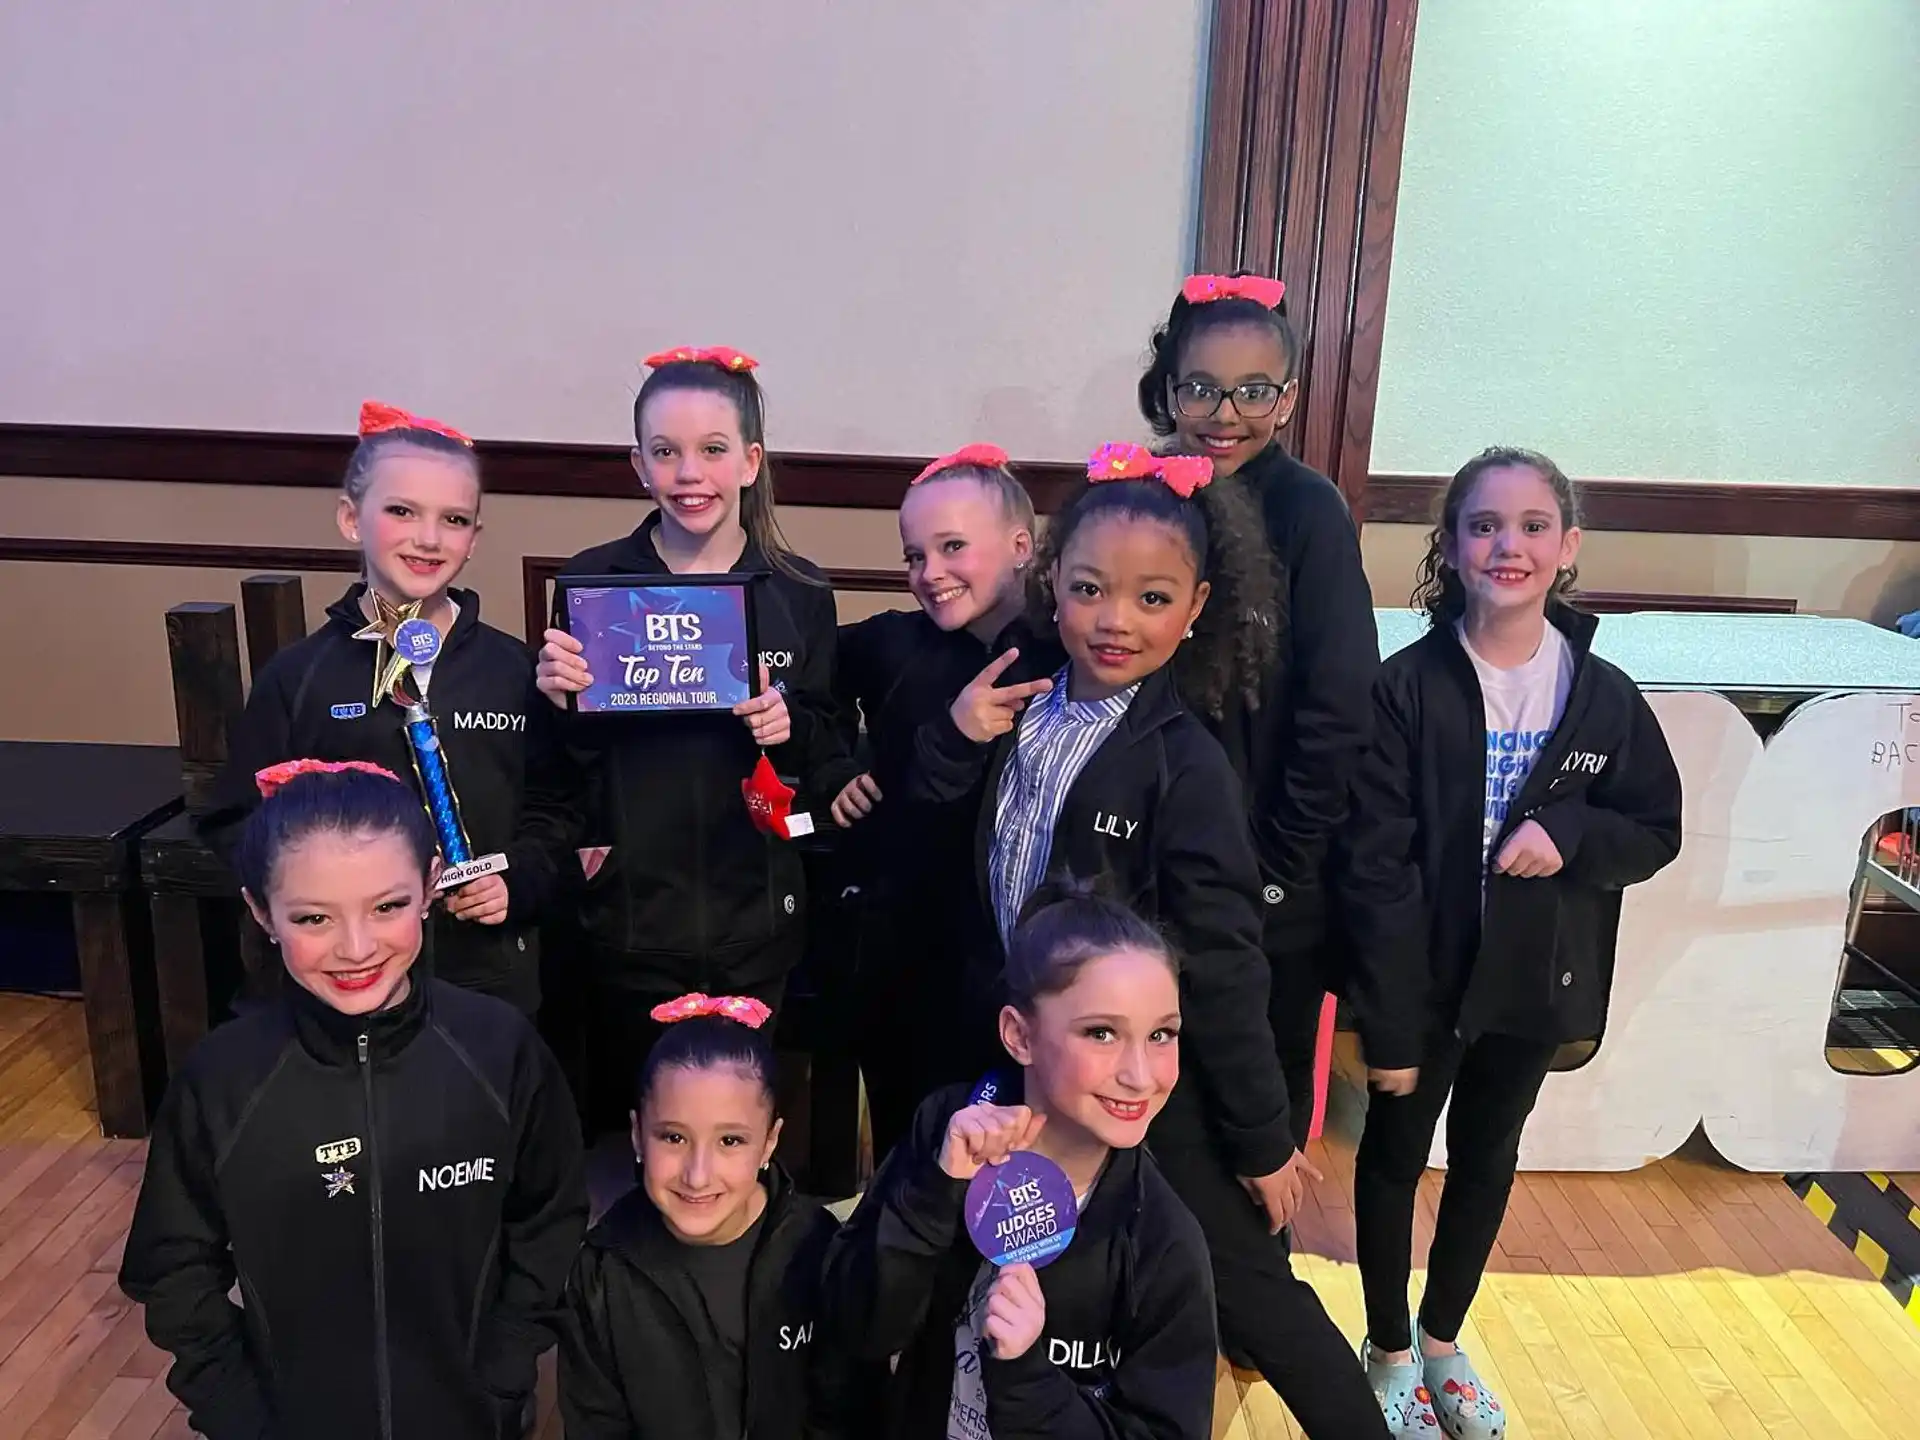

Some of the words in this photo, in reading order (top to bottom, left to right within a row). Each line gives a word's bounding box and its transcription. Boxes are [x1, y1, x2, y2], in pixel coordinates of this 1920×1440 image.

[411, 633, 433, 647] BTS
[646, 613, 702, 641] BTS
[618, 654, 660, 690] Top
[663, 654, 705, 686] Ten
[611, 693, 638, 706] 2023
[640, 691, 689, 705] REGIONAL
[690, 690, 717, 703] TOUR
[1093, 811, 1139, 839] LILY
[441, 870, 464, 883] HIGH
[466, 862, 492, 876] GOLD
[320, 1141, 358, 1160] TTB
[418, 1157, 495, 1192] NOEMIE
[1009, 1181, 1041, 1207] BTS
[995, 1202, 1056, 1239] JUDGES
[1004, 1219, 1057, 1252] AWARD
